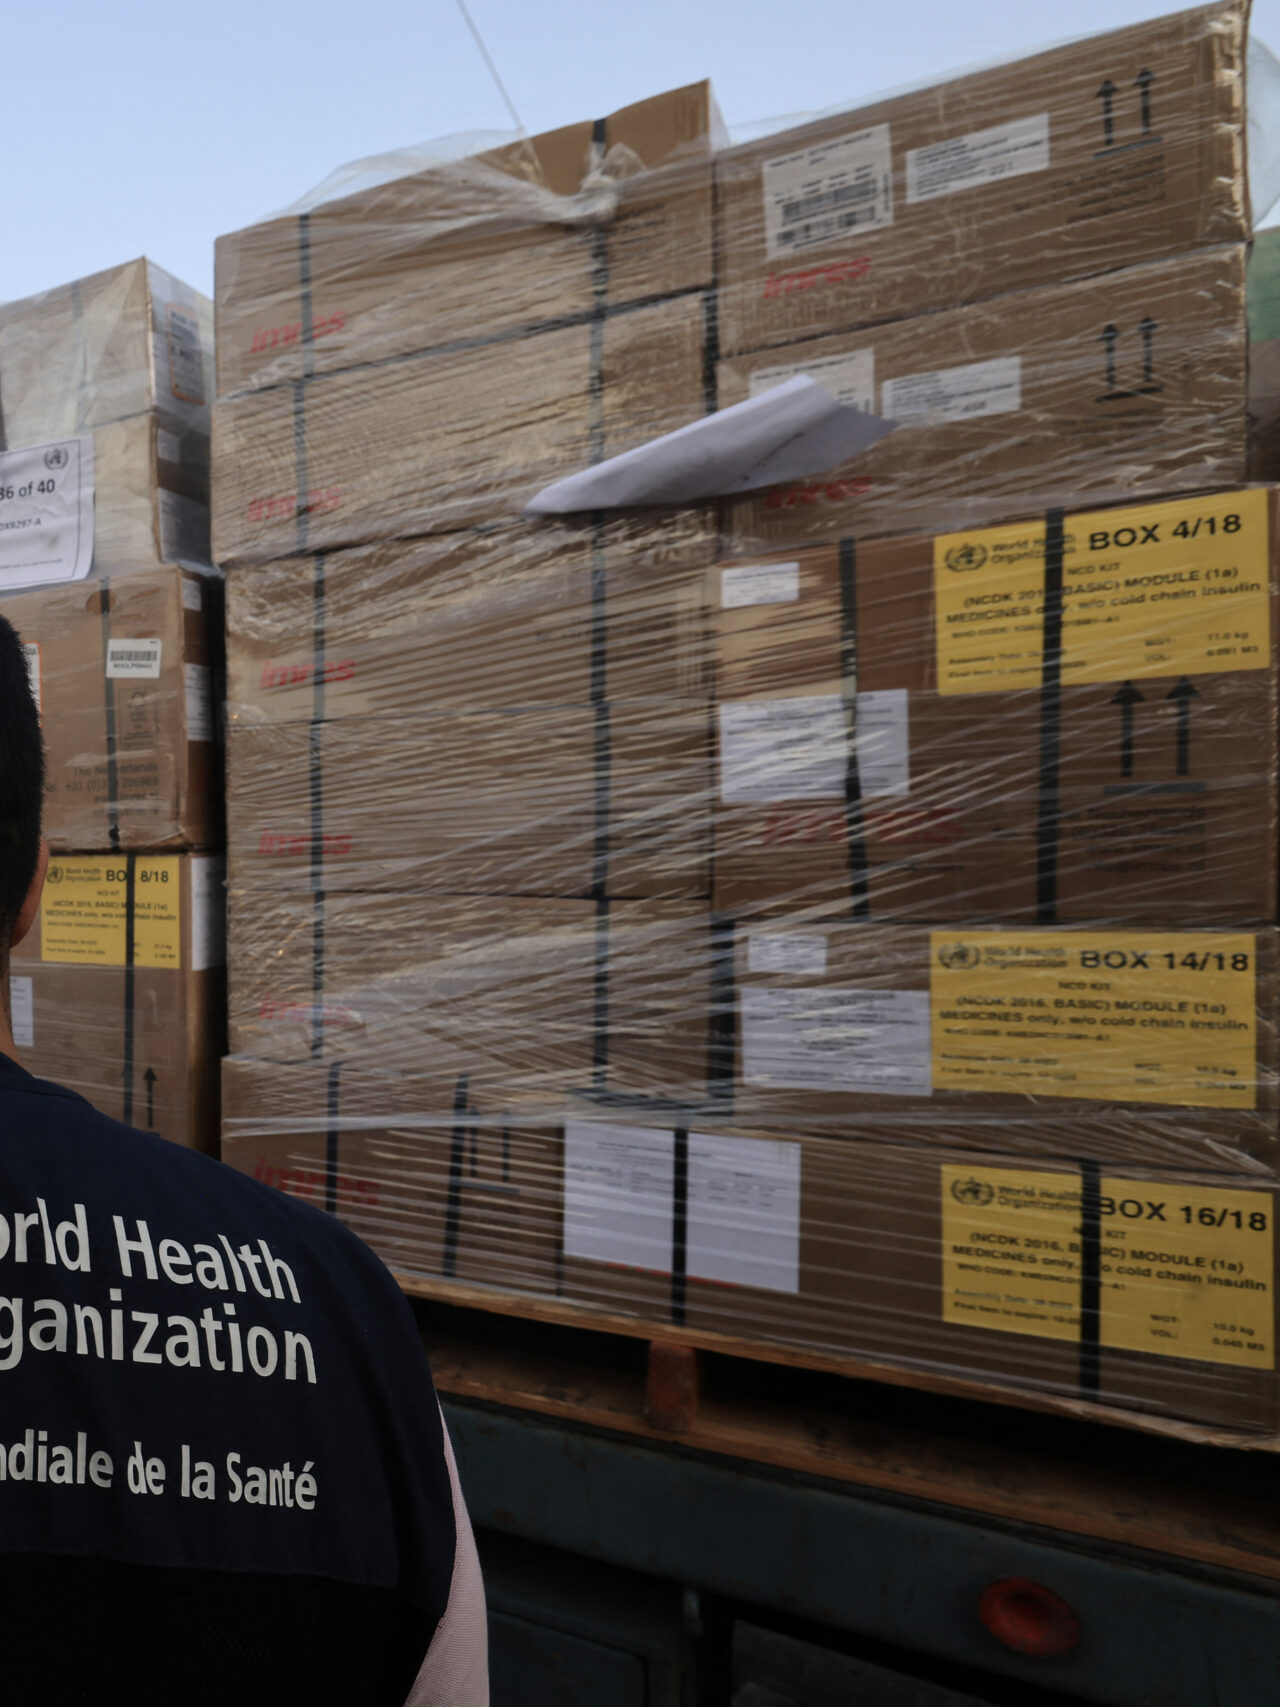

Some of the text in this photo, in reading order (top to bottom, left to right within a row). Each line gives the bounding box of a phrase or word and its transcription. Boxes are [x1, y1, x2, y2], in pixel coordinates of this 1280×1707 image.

[18, 482, 34, 497] of
[37, 478, 55, 494] 40
[1088, 514, 1242, 551] BOX 4/18
[1124, 570, 1200, 588] MODULE
[1205, 566, 1240, 581] (1a)
[946, 605, 1032, 624] MEDICINES
[1109, 592, 1147, 607] cold
[1150, 587, 1198, 603] chain
[1201, 581, 1262, 597] insulin
[140, 869, 169, 883] 8/18
[1080, 950, 1150, 970] BOX
[1162, 951, 1249, 971] 14/18
[939, 1010, 1024, 1022] MEDICINES
[1100, 1016, 1136, 1027] cold
[1139, 1017, 1186, 1029] chain
[1189, 1019, 1249, 1031] insulin
[1053, 998, 1111, 1012] BASIC)
[1114, 1000, 1189, 1013] MODULE
[1193, 1002, 1227, 1016] (1a)
[1099, 1196, 1168, 1222] BOX
[1179, 1204, 1267, 1232] 16/18
[112, 1215, 302, 1304] Health
[952, 1244, 1039, 1264] MEDICINES
[1115, 1263, 1153, 1278] cold
[1155, 1268, 1203, 1284] chain
[1206, 1273, 1267, 1292] insulin
[970, 1232, 1020, 1245] (NCDK
[1130, 1249, 1207, 1268] MODULE
[1210, 1258, 1245, 1275] (1a)
[127, 1442, 166, 1496] de
[181, 1444, 216, 1502] la
[227, 1452, 318, 1510] Santé
